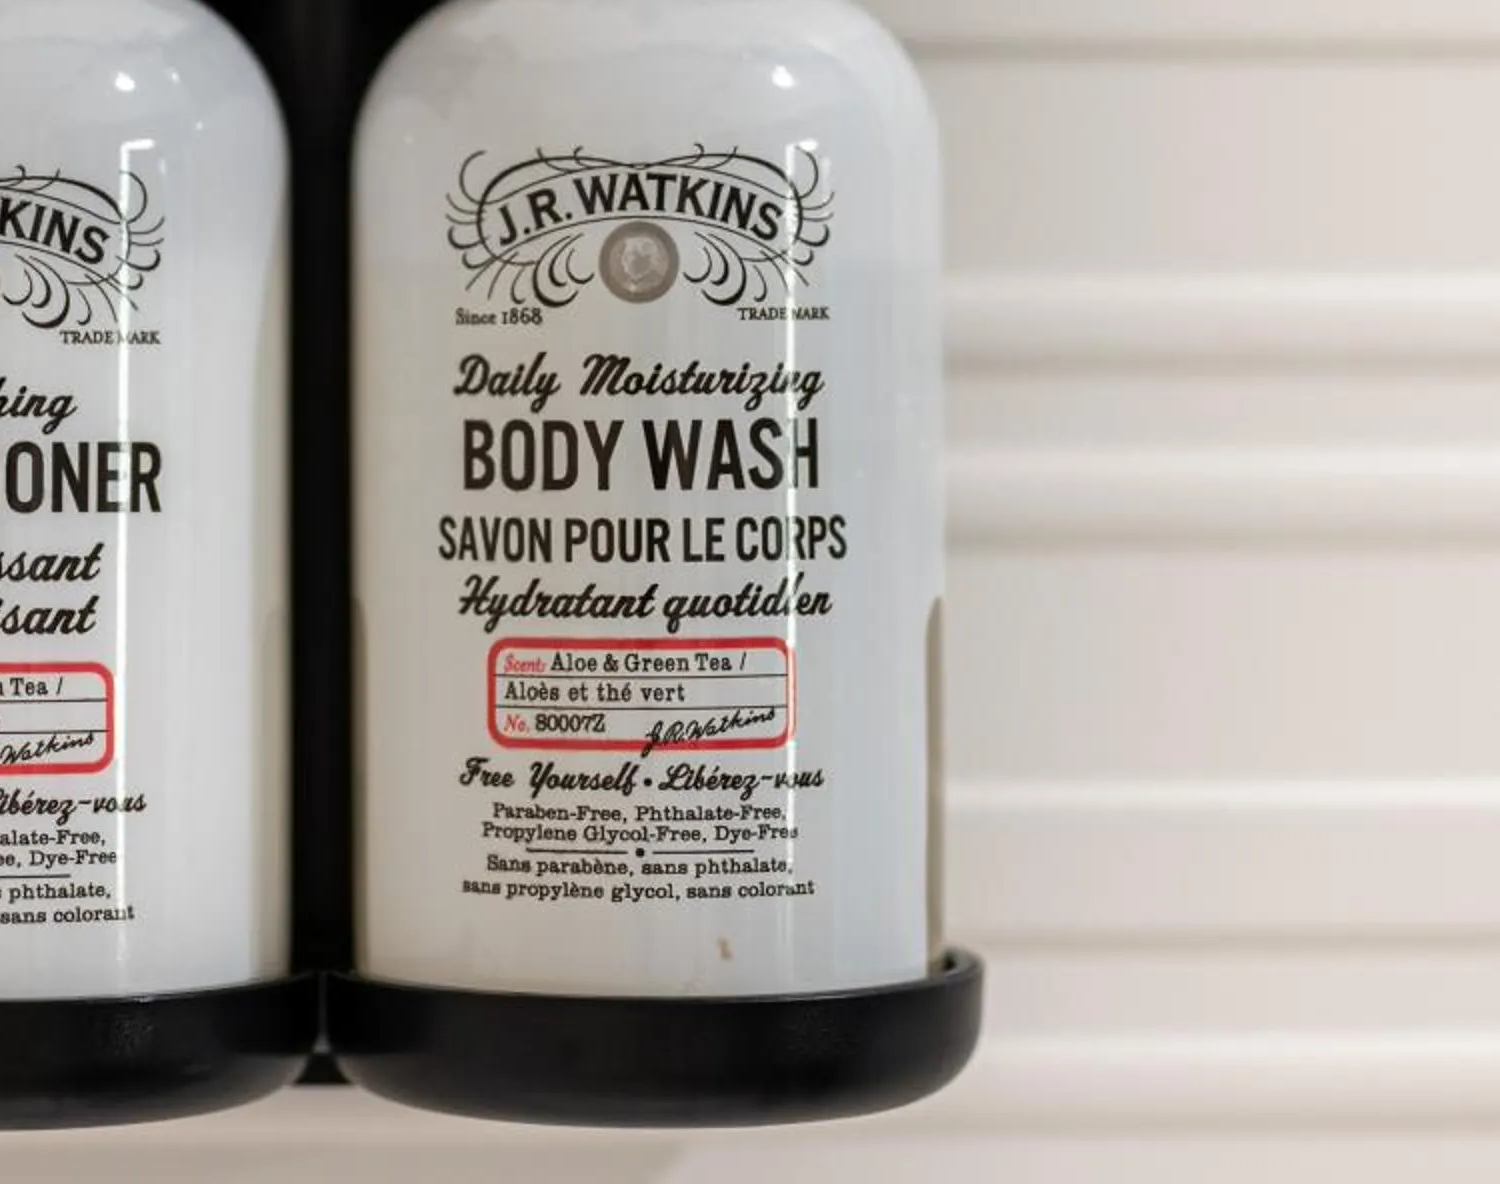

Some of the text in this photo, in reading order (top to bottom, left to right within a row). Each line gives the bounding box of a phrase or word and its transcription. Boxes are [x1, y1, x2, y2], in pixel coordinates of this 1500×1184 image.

[496, 172, 784, 247] J.R. WATKINS
[455, 307, 544, 326] Since 1868
[737, 306, 786, 322] TRADE
[60, 330, 113, 344] TRADE
[453, 351, 826, 414] Daily Moisturizing
[463, 416, 819, 492] BODY WASH
[438, 514, 848, 564] SAVON POUR LE CORPS
[457, 574, 659, 635] Hydratant
[503, 654, 546, 673] Scent:
[550, 653, 598, 672] Aloe
[603, 654, 620, 672] &
[624, 653, 690, 672] Green
[695, 653, 733, 672] Tea
[10, 678, 49, 696] Tea
[504, 681, 686, 702] Aloès et thé vert
[503, 714, 606, 733] No. 80007Z
[459, 757, 515, 788] Free
[529, 761, 638, 798] Yourself
[493, 802, 787, 823] Paraben-Free, Phthalate-Free,
[482, 822, 577, 844] Propylene
[582, 824, 708, 845] Glycol-Free,
[28, 850, 117, 868] Dye-Free
[487, 855, 794, 880] Sans parabène, sans phthalate,
[8, 883, 112, 904] phthalate,
[462, 879, 815, 904] sans propylène glycol, sans colorant
[0, 910, 48, 924] sans
[53, 906, 136, 924] colorant
